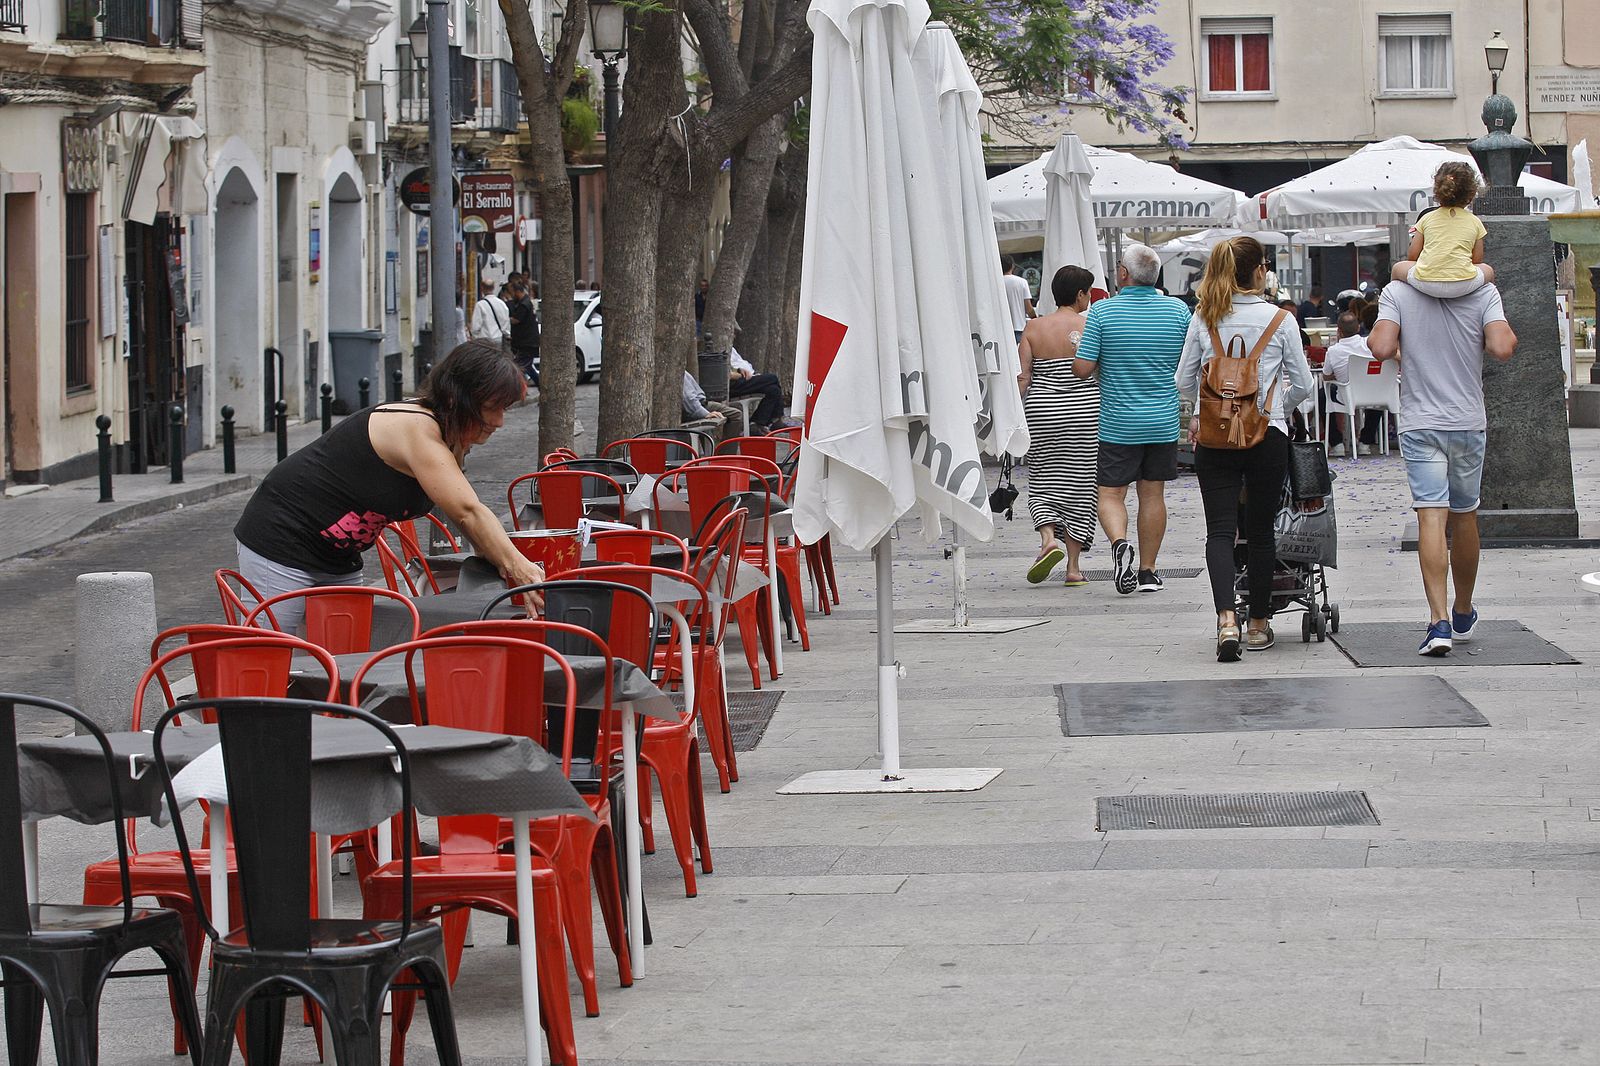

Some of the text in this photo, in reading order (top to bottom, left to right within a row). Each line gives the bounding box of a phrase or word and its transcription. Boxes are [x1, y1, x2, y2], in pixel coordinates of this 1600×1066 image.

[1541, 94, 1576, 103] MENDEZ
[476, 182, 512, 190] Restaurante
[463, 192, 512, 208] El Serrallo
[1092, 200, 1211, 217] uzcampo
[1281, 544, 1317, 554] TARIFA
